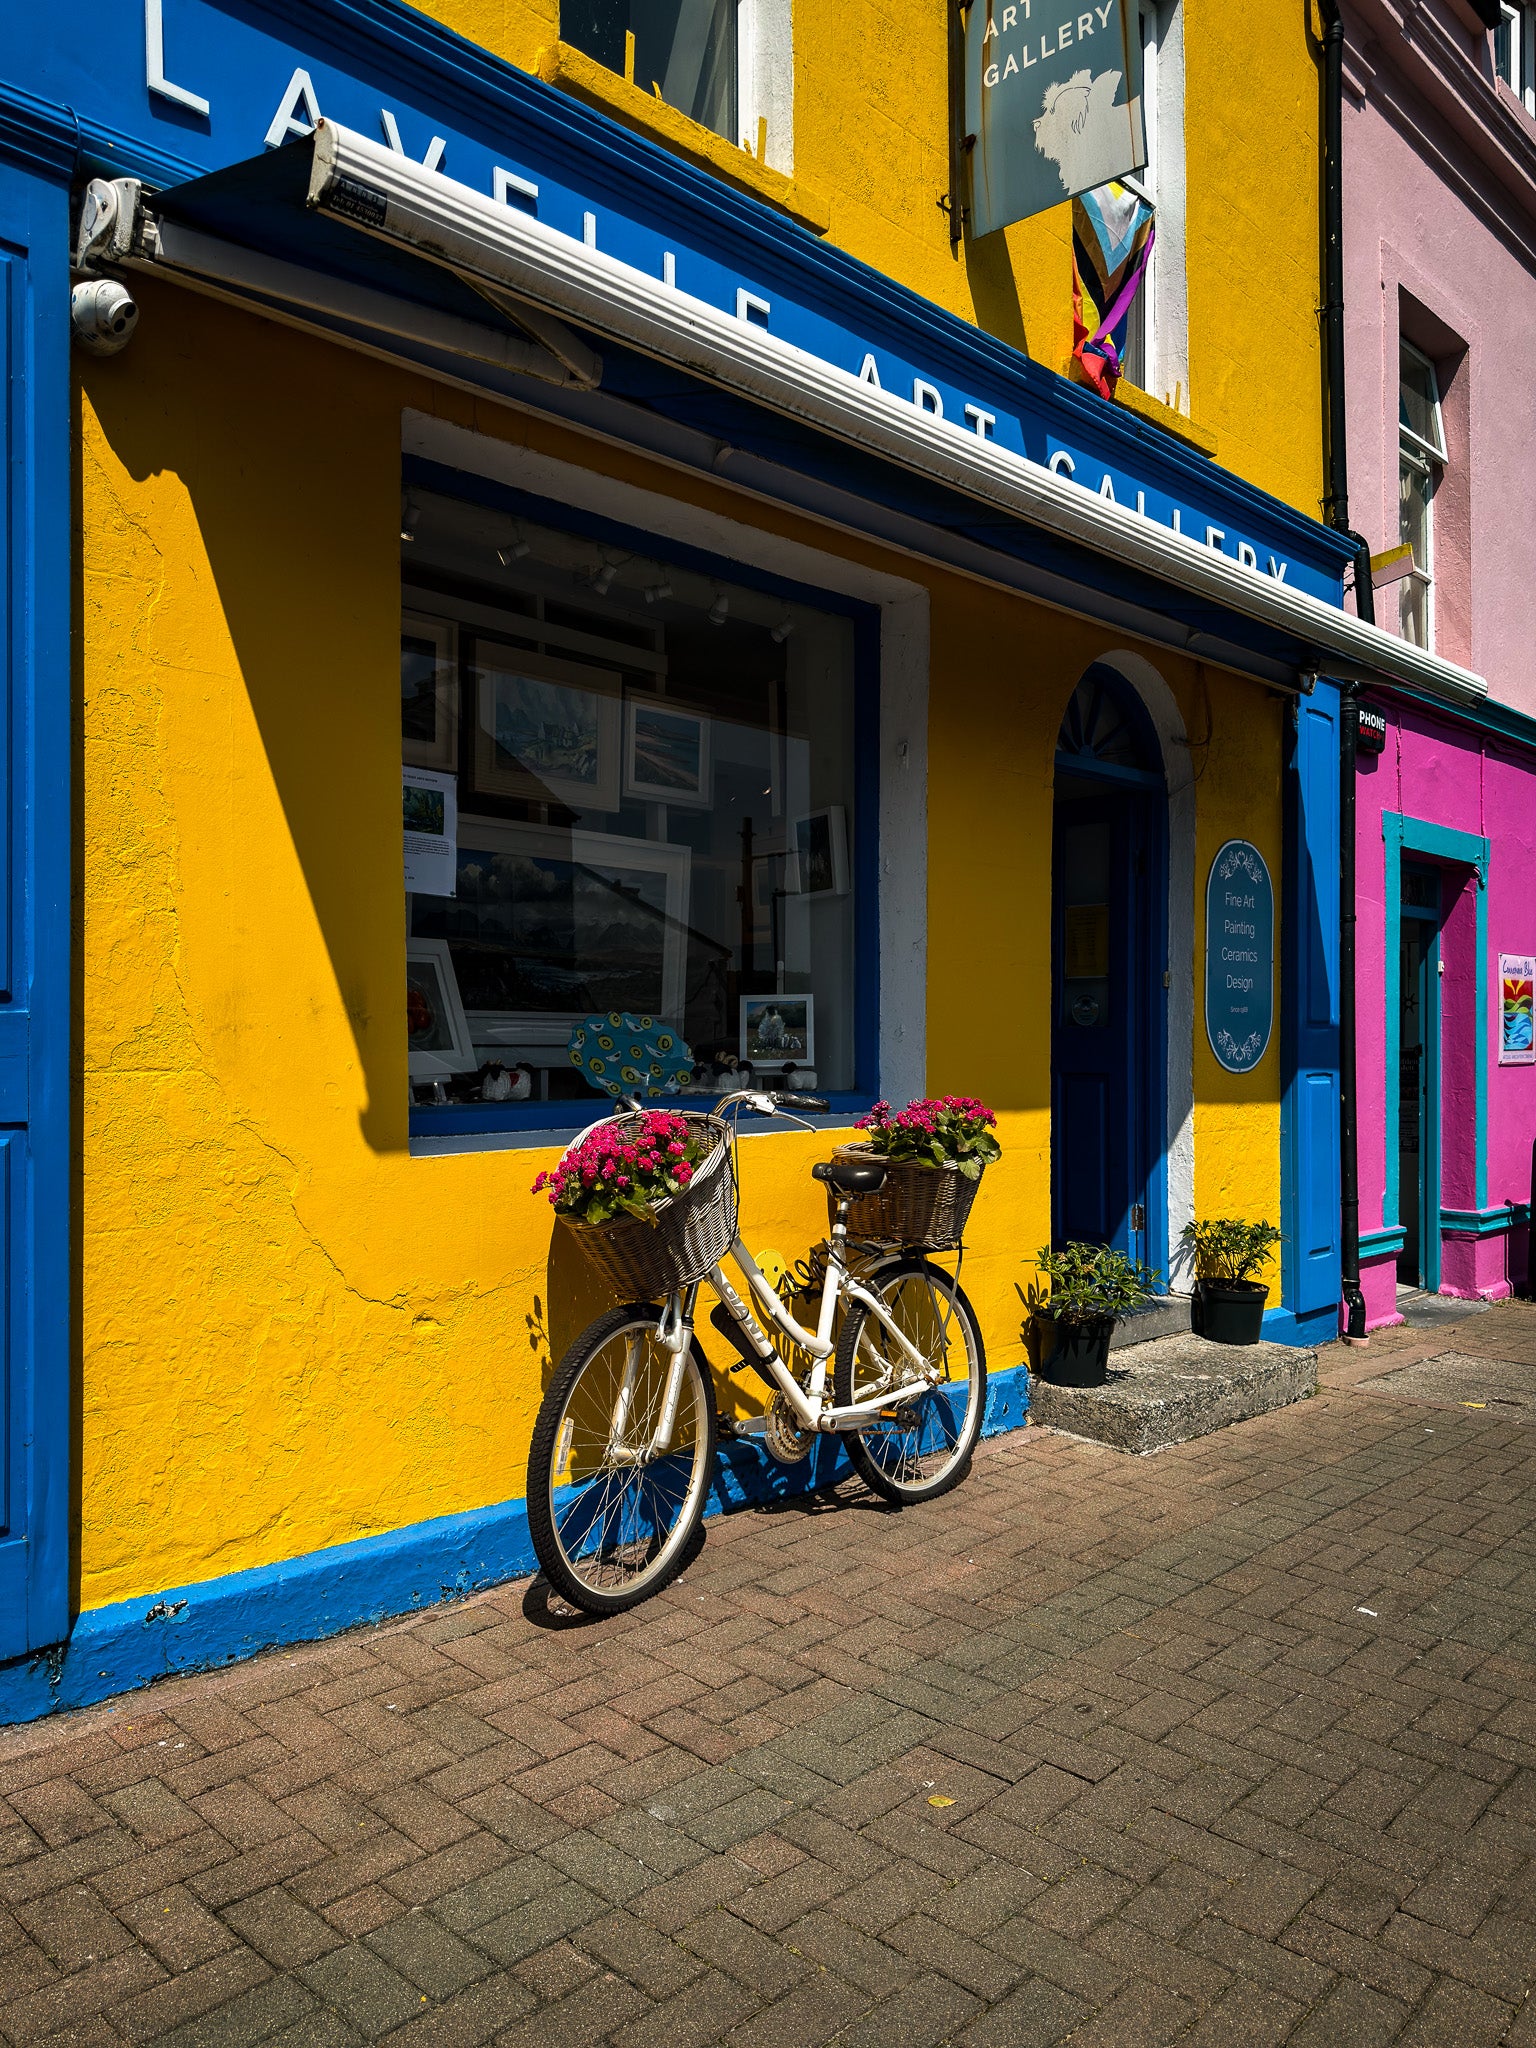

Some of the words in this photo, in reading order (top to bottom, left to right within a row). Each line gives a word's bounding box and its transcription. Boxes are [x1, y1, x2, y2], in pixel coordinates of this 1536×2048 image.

[983, 0, 1032, 44] ART
[983, 0, 1113, 88] GALLERY
[1359, 710, 1385, 732] PHONE
[1225, 892, 1242, 907] Fine
[1243, 894, 1255, 909] Art
[1224, 919, 1255, 939] Painting
[1221, 947, 1258, 963] Ceramics
[1226, 974, 1253, 993] Design
[722, 1282, 767, 1344] GIANT
